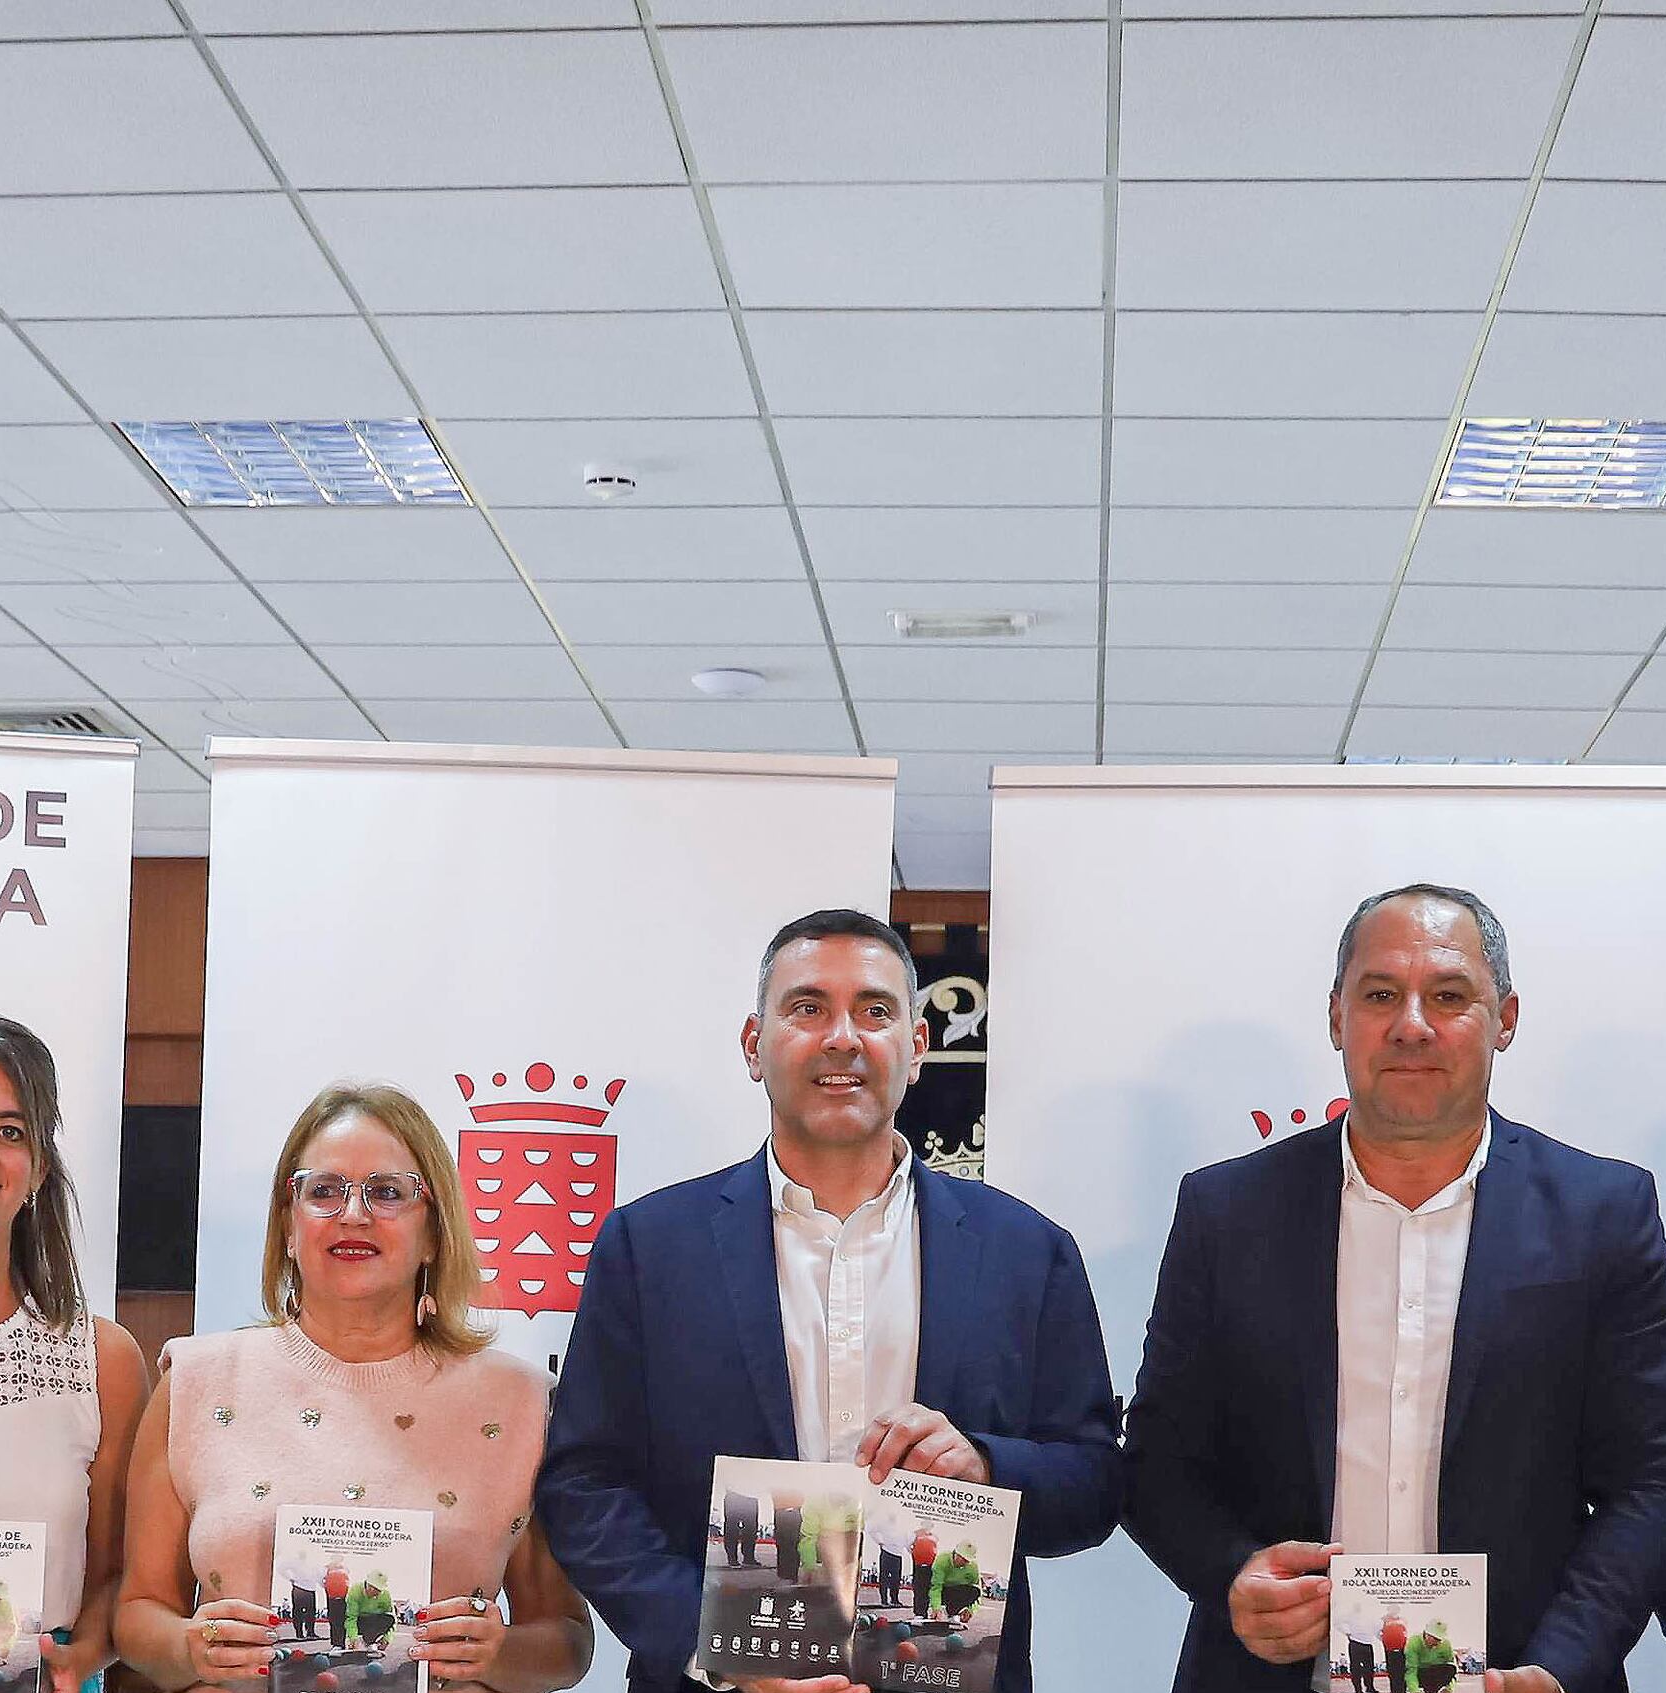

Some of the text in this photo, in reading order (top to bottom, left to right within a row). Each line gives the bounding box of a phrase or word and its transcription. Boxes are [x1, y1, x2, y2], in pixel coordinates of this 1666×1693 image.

[893, 1479, 994, 1507] XXII TORNEO DE
[301, 1516, 401, 1531] XXII TORNEO DE
[4, 1531, 21, 1541] DE
[1354, 1567, 1458, 1577] XXII TORNEO DE
[901, 1663, 962, 1688] FASE
